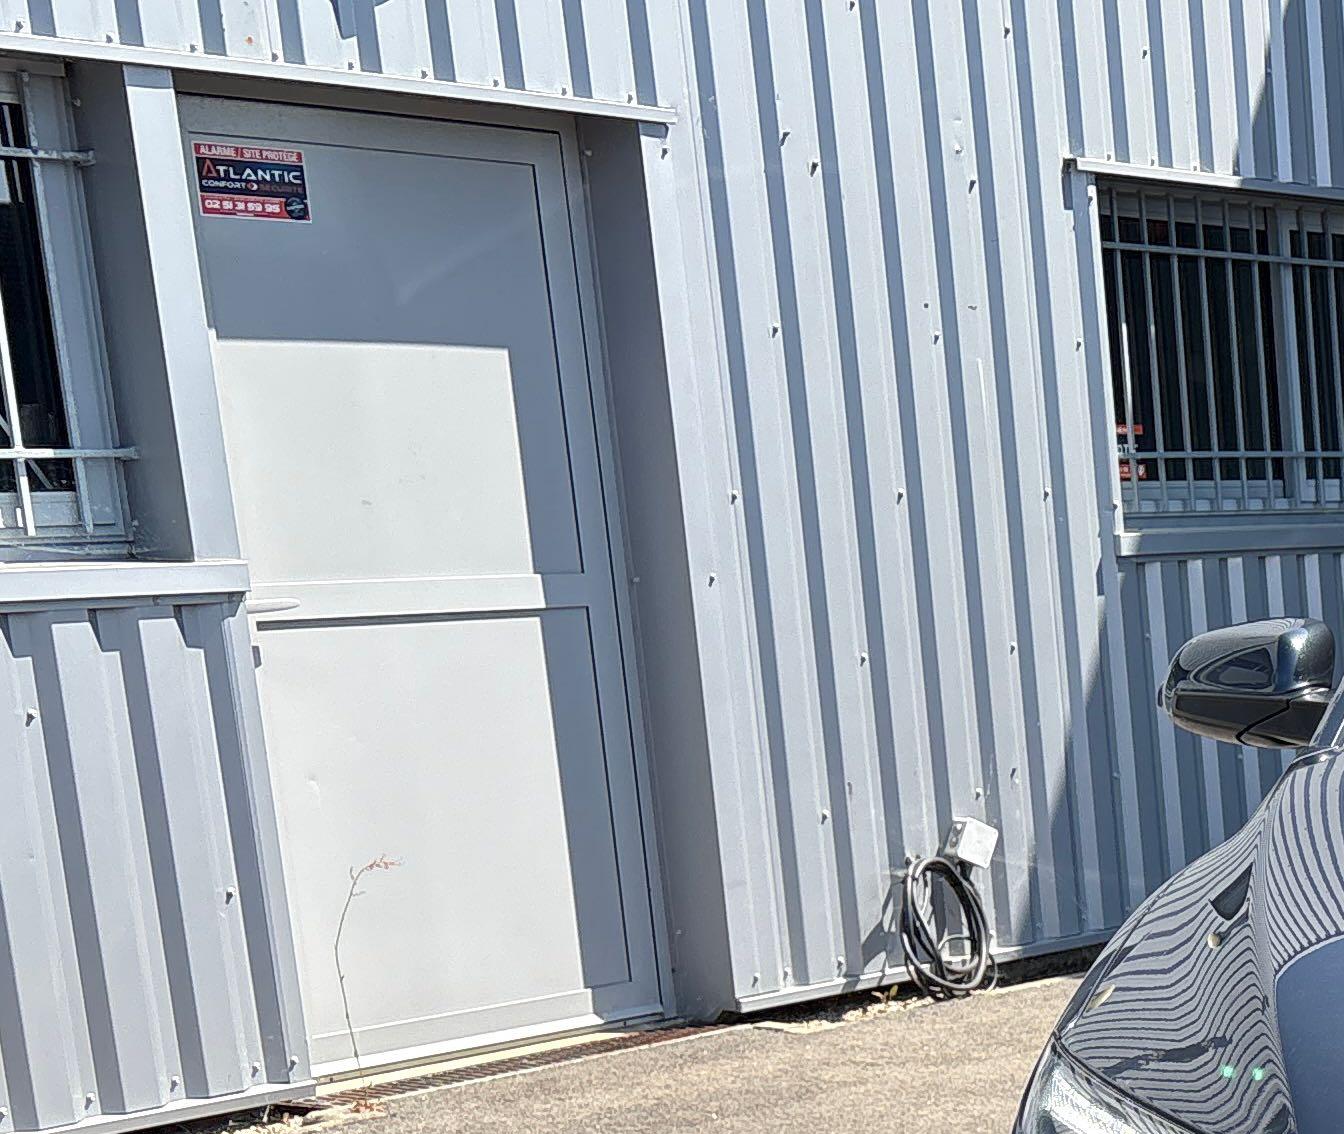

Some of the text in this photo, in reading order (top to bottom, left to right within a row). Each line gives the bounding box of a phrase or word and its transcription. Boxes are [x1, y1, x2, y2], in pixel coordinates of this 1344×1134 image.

[200, 144, 237, 157] ALARME
[243, 148, 262, 159] SITE
[202, 158, 303, 184] ATLANTIC
[202, 180, 246, 189] CONFORT
[205, 199, 221, 209] 02
